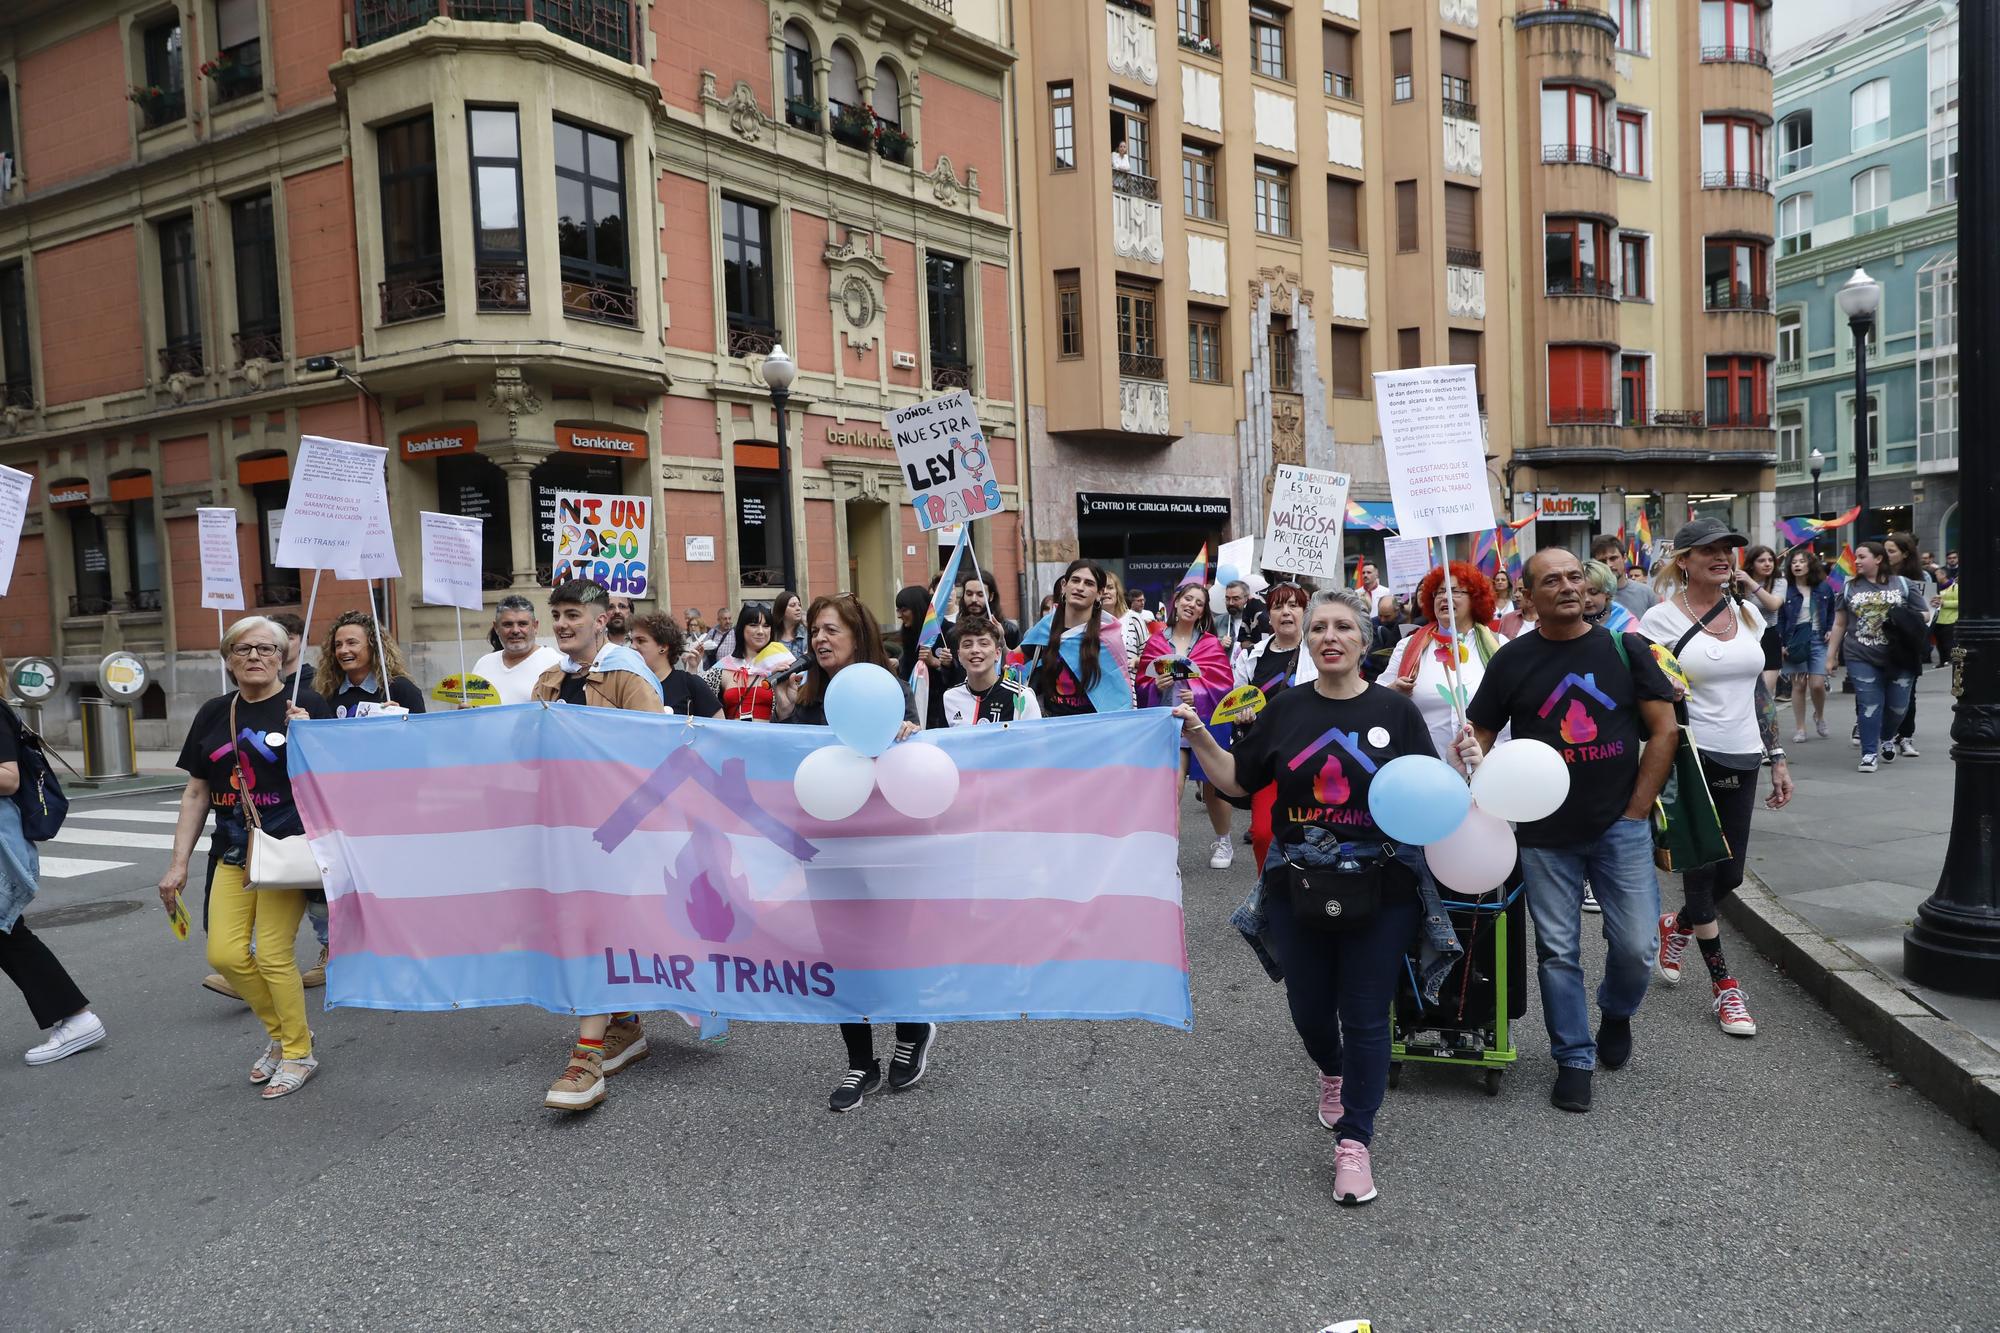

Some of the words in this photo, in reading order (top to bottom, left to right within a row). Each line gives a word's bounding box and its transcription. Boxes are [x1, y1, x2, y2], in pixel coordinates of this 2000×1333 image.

[896, 406, 933, 424] DÓNDE
[938, 395, 963, 411] ESTÁ
[897, 416, 971, 448] NUESTRA
[907, 449, 956, 491] LEY
[1407, 463, 1449, 474] NECESITAMOS
[1449, 461, 1461, 470] QUE
[1279, 469, 1292, 479] TU
[1298, 472, 1346, 487] IDENTIDAD
[1409, 474, 1444, 485] GARANTICE
[1444, 472, 1470, 481] NUESTRO
[1291, 482, 1303, 493] ES
[1309, 485, 1321, 495] TU
[1410, 486, 1441, 497] DERECHO
[305, 492, 343, 503] NECESITAMOS
[911, 479, 1001, 529] TRANS
[294, 508, 321, 517] DERECHO
[303, 501, 335, 511] GARANTICE
[559, 498, 603, 525] NI
[610, 500, 645, 529] UN
[1091, 501, 1125, 511] CENTRO
[1126, 502, 1137, 511] DE
[1138, 503, 1169, 512] CIRUGIA
[1170, 504, 1194, 513] FACIAL
[1195, 504, 1201, 513] &
[1203, 504, 1228, 514] DENTAL
[1292, 503, 1318, 517] MAS
[1436, 504, 1459, 514] TRANS
[1273, 511, 1336, 536] VALIOSA
[313, 537, 336, 547] TRANS
[558, 524, 639, 560] PASO
[1284, 546, 1291, 555] A
[1297, 547, 1323, 560] TODA
[1129, 562, 1151, 570] CENTRO
[1275, 555, 1324, 574] COSTA
[551, 559, 647, 595] ATRÁS
[1578, 740, 1624, 762] TRANS
[211, 791, 236, 806] LLAR
[1288, 806, 1323, 822] LLAR
[1325, 807, 1372, 827] TRANS
[604, 946, 697, 993] LLAR
[708, 953, 836, 997] TRANS
